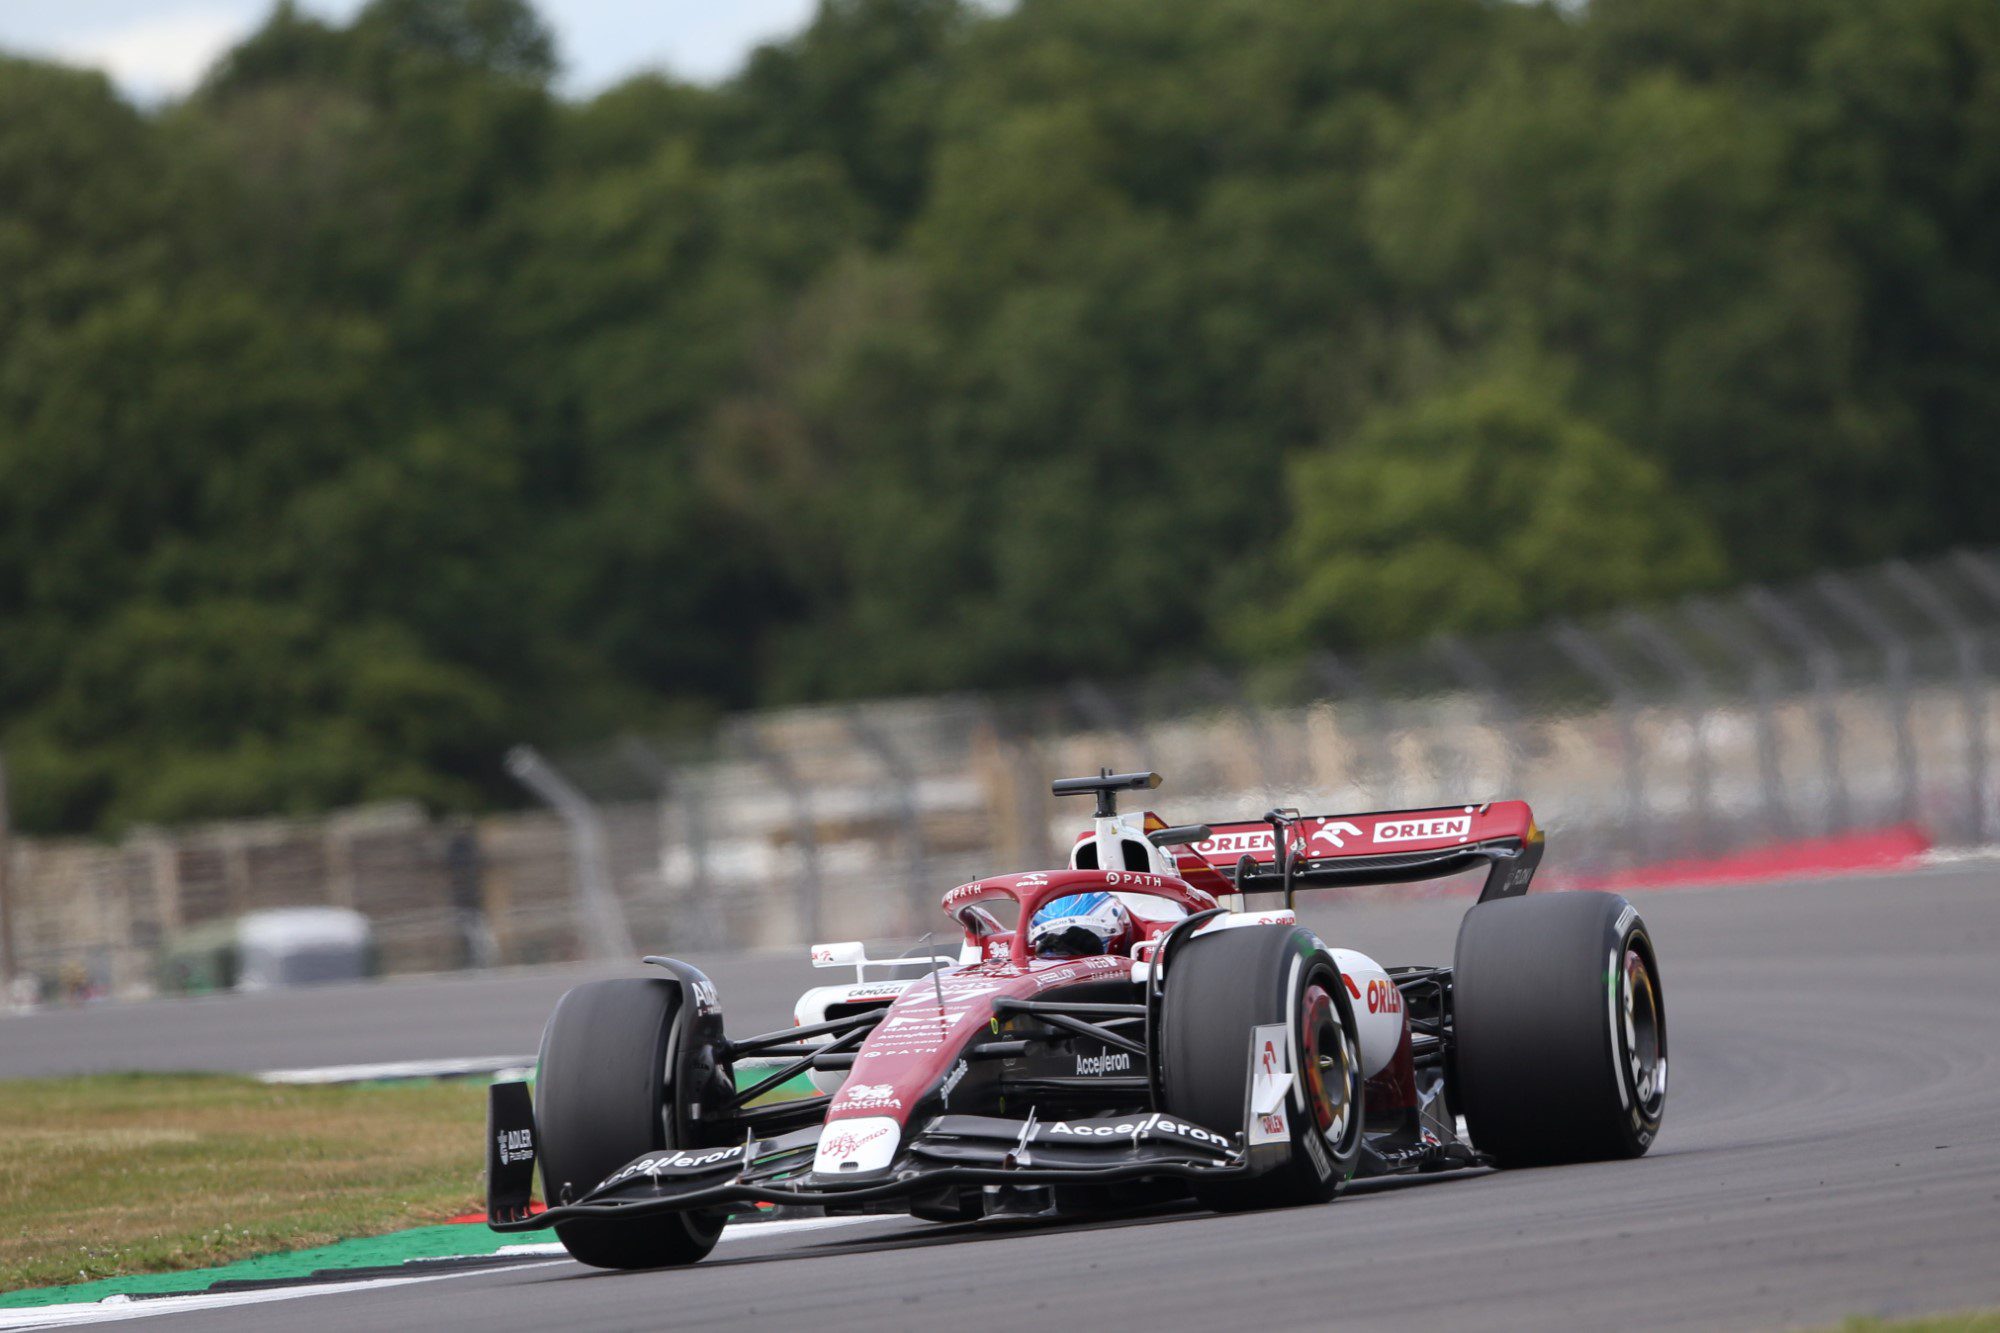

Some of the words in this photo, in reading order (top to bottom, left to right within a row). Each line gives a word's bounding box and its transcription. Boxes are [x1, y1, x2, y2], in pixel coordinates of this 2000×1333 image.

[1380, 820, 1464, 840] ORLEN
[1197, 833, 1276, 852] ORLEN
[1123, 874, 1162, 887] PATH
[953, 883, 982, 899] PATH
[885, 1047, 938, 1056] PATH
[1076, 1046, 1130, 1077] Accelleron
[830, 1098, 902, 1112] SINGHA
[508, 1129, 533, 1150] ADLER
[1050, 1113, 1230, 1148] Accelleron
